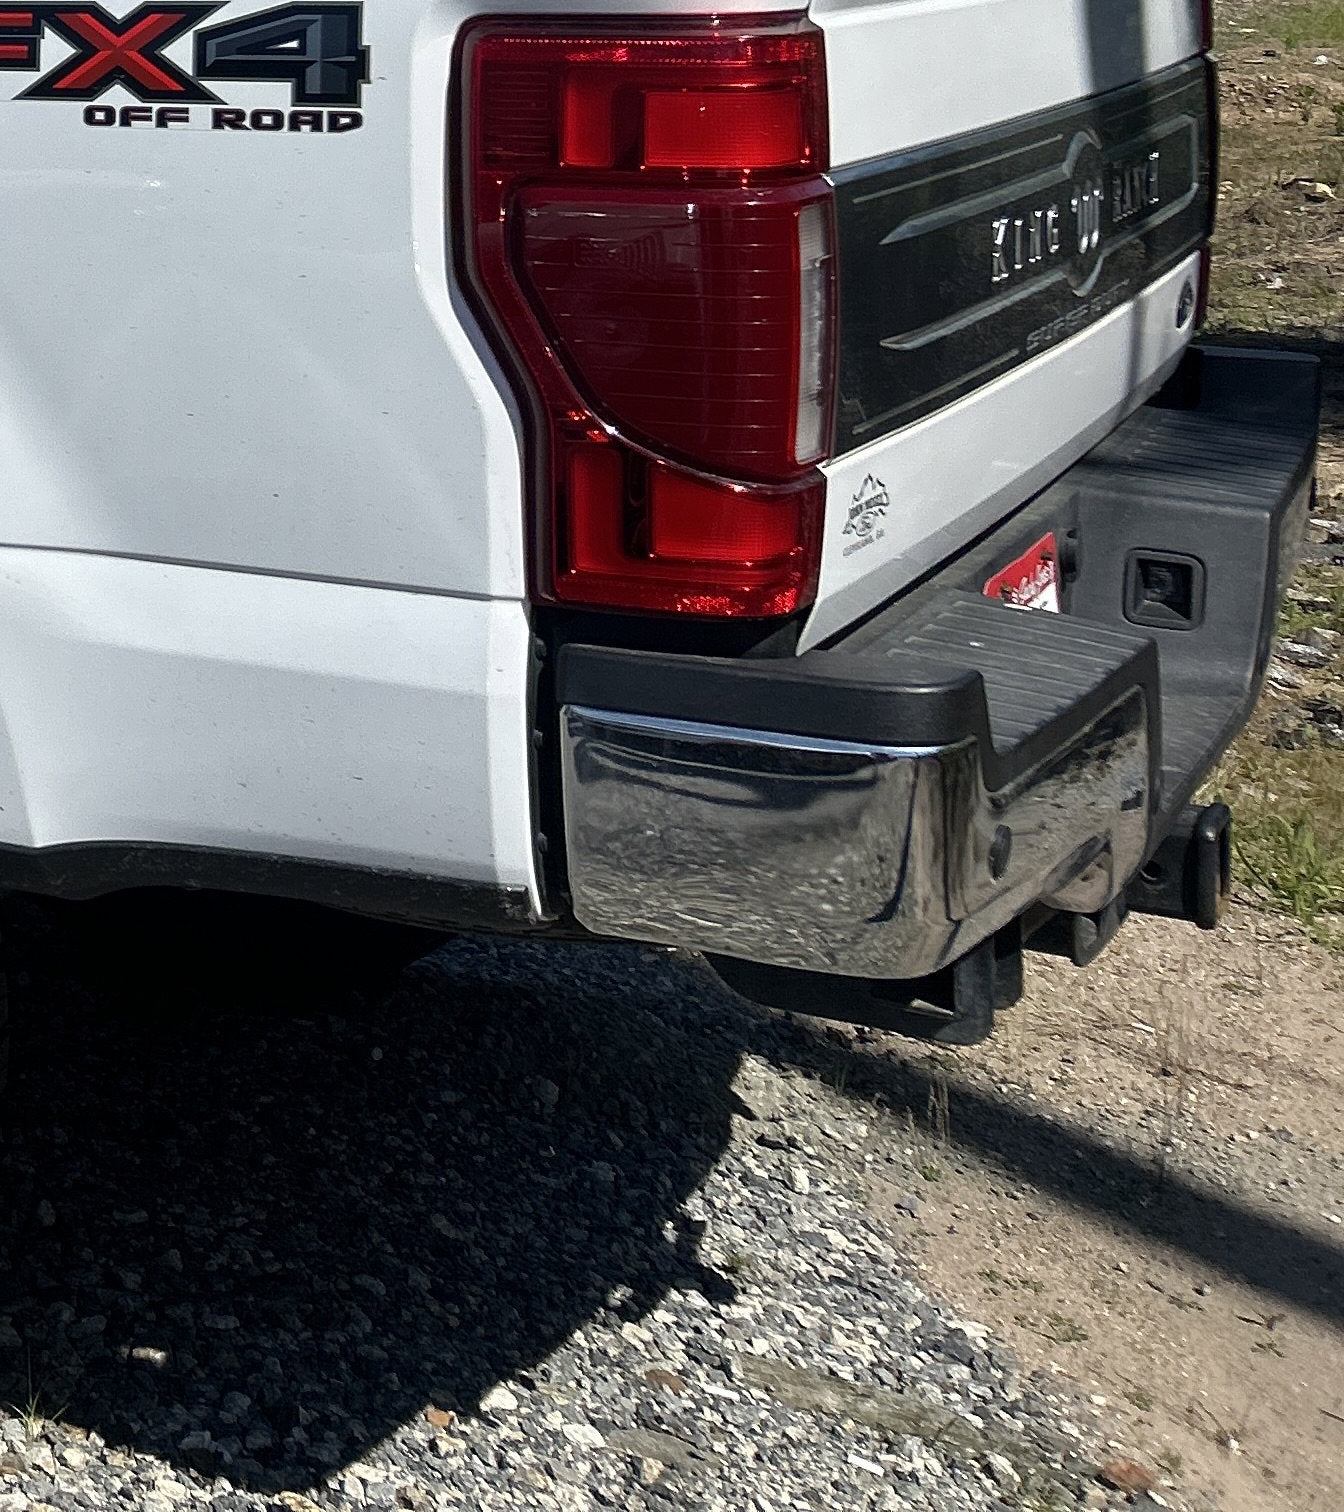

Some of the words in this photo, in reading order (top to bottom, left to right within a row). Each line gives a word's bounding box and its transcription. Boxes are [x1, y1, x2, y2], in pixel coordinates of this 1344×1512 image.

[83, 105, 190, 129] OFF
[212, 107, 364, 133] ROAD
[992, 203, 1059, 282] KING
